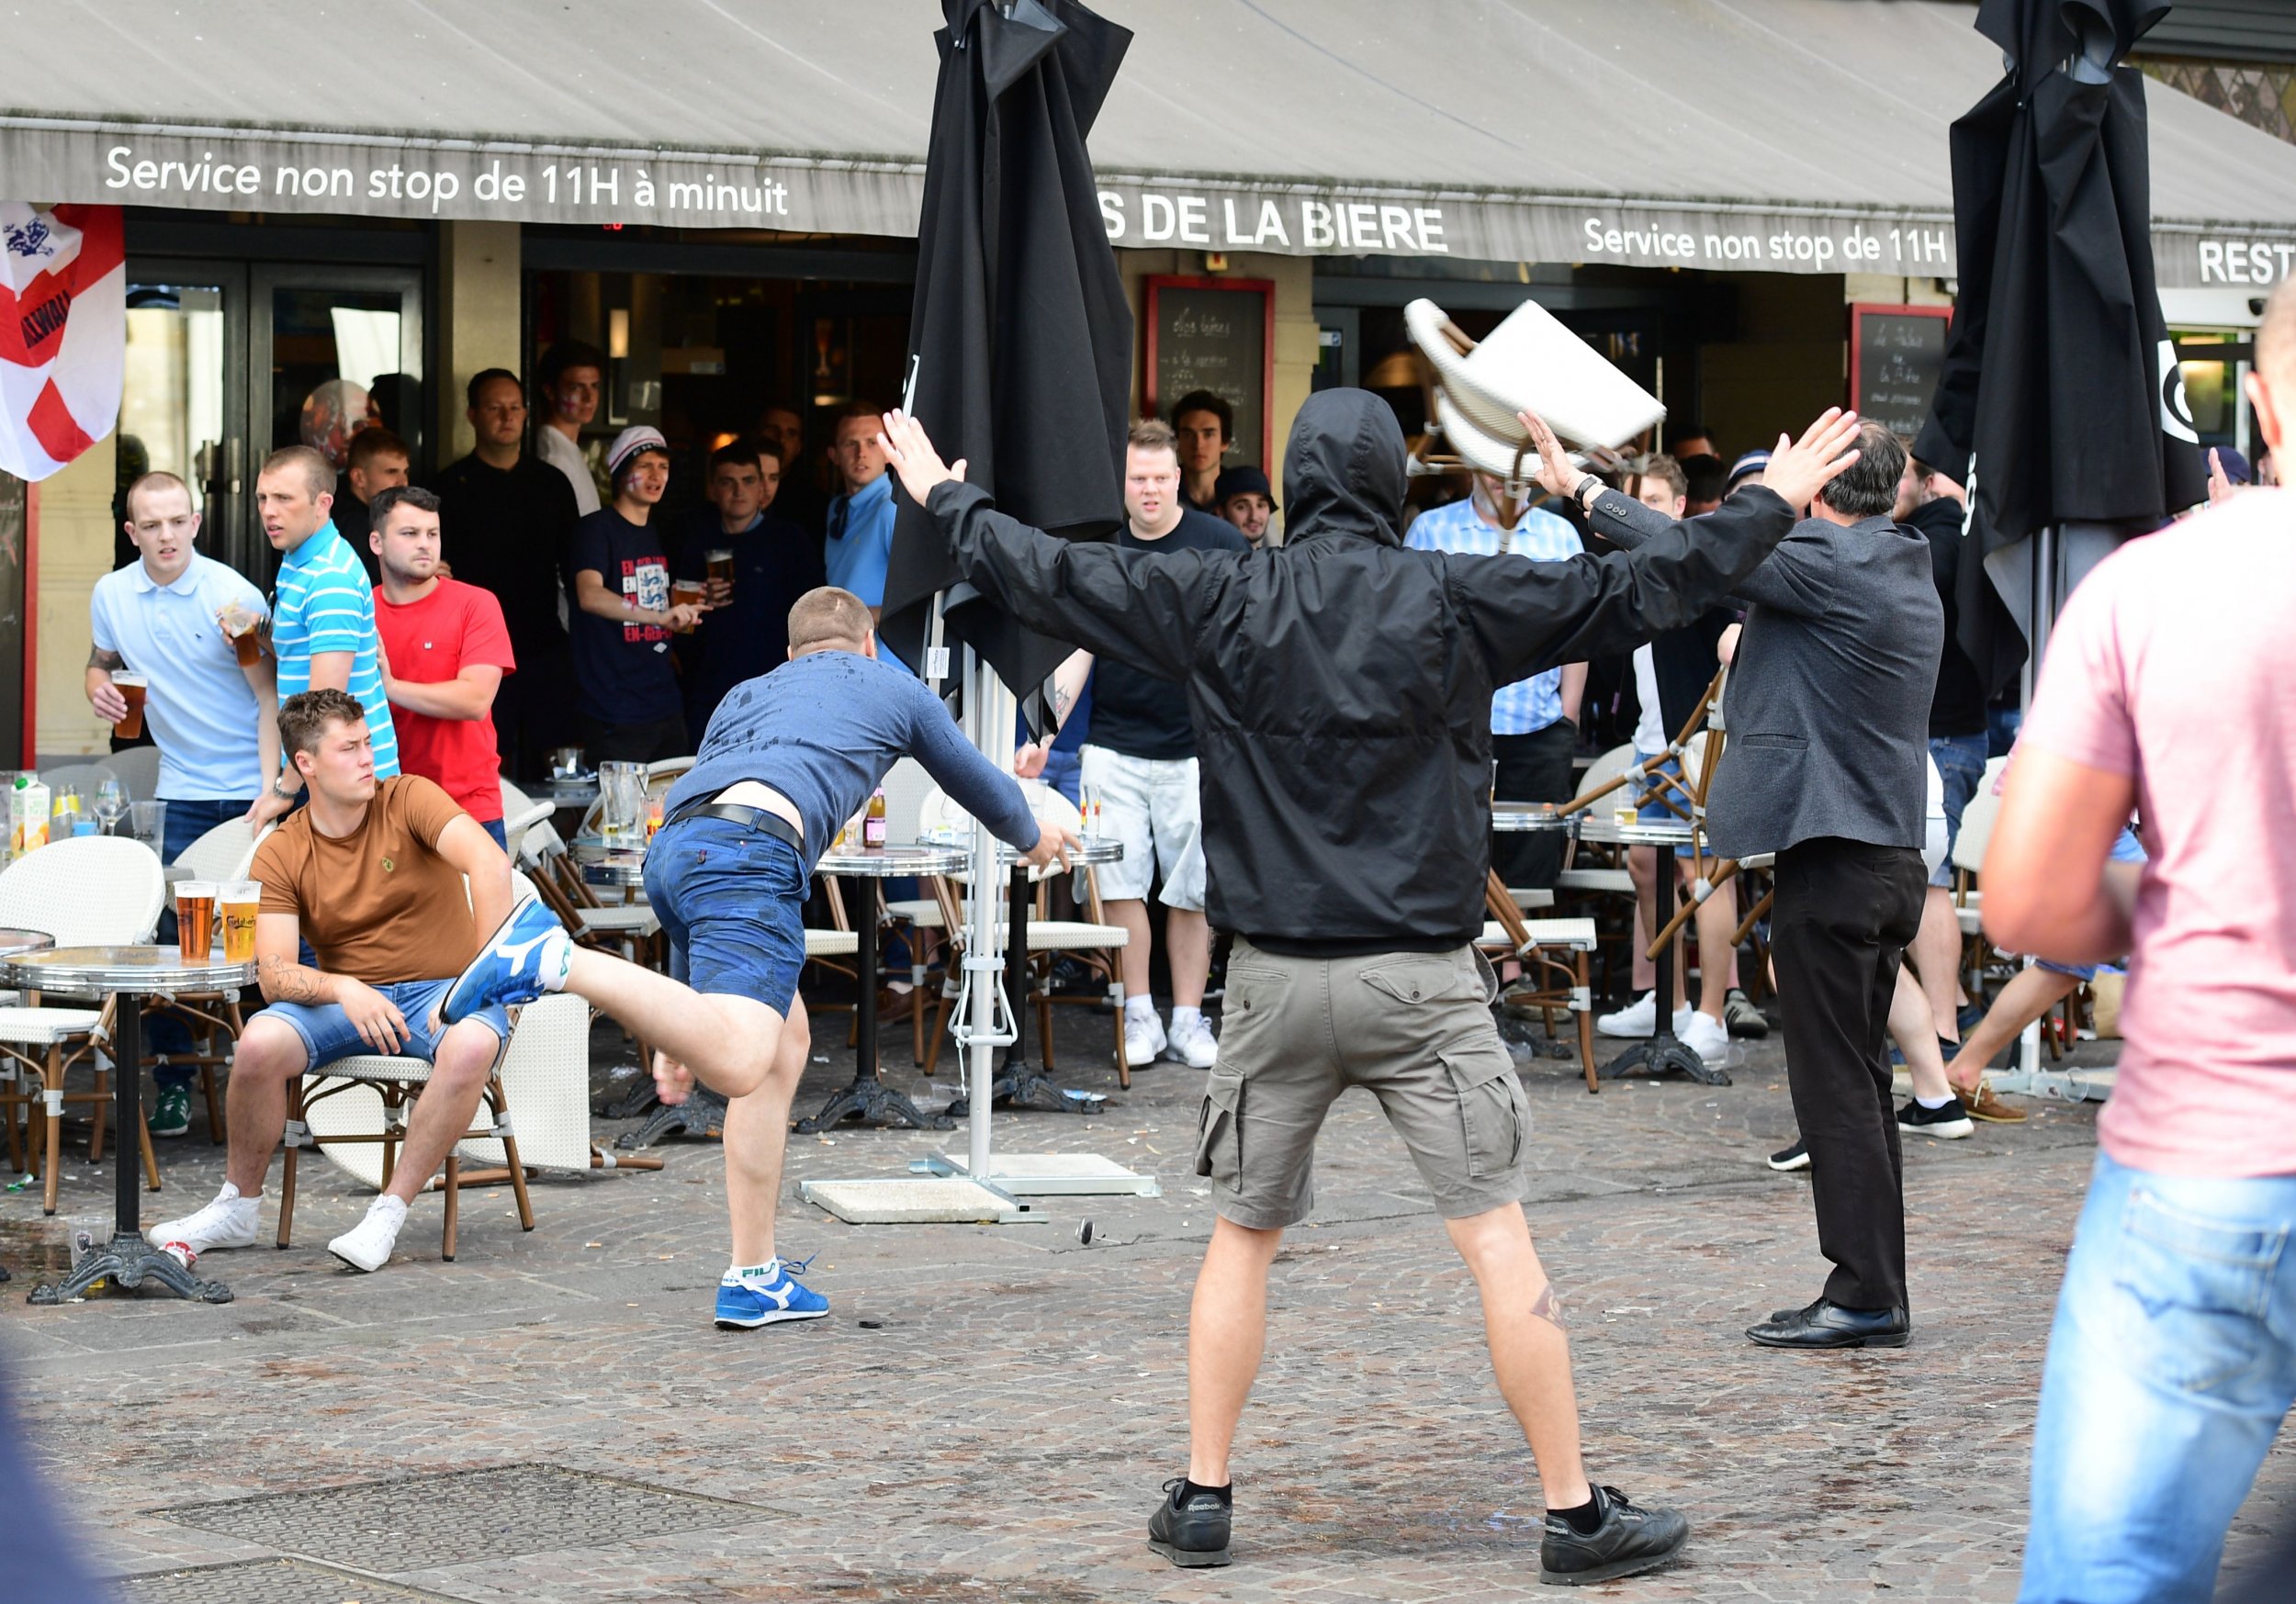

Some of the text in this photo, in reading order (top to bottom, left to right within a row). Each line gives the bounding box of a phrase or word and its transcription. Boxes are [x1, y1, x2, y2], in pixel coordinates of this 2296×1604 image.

[106, 146, 789, 216] Service non stop de 11H à minuit
[1142, 194, 1210, 243] DE
[1224, 198, 1289, 246] LA
[1301, 201, 1448, 252] BIERE
[1583, 218, 1948, 272] Service non stop de 11H
[2199, 241, 2296, 285] REST
[1187, 1502, 1221, 1512] Reebok
